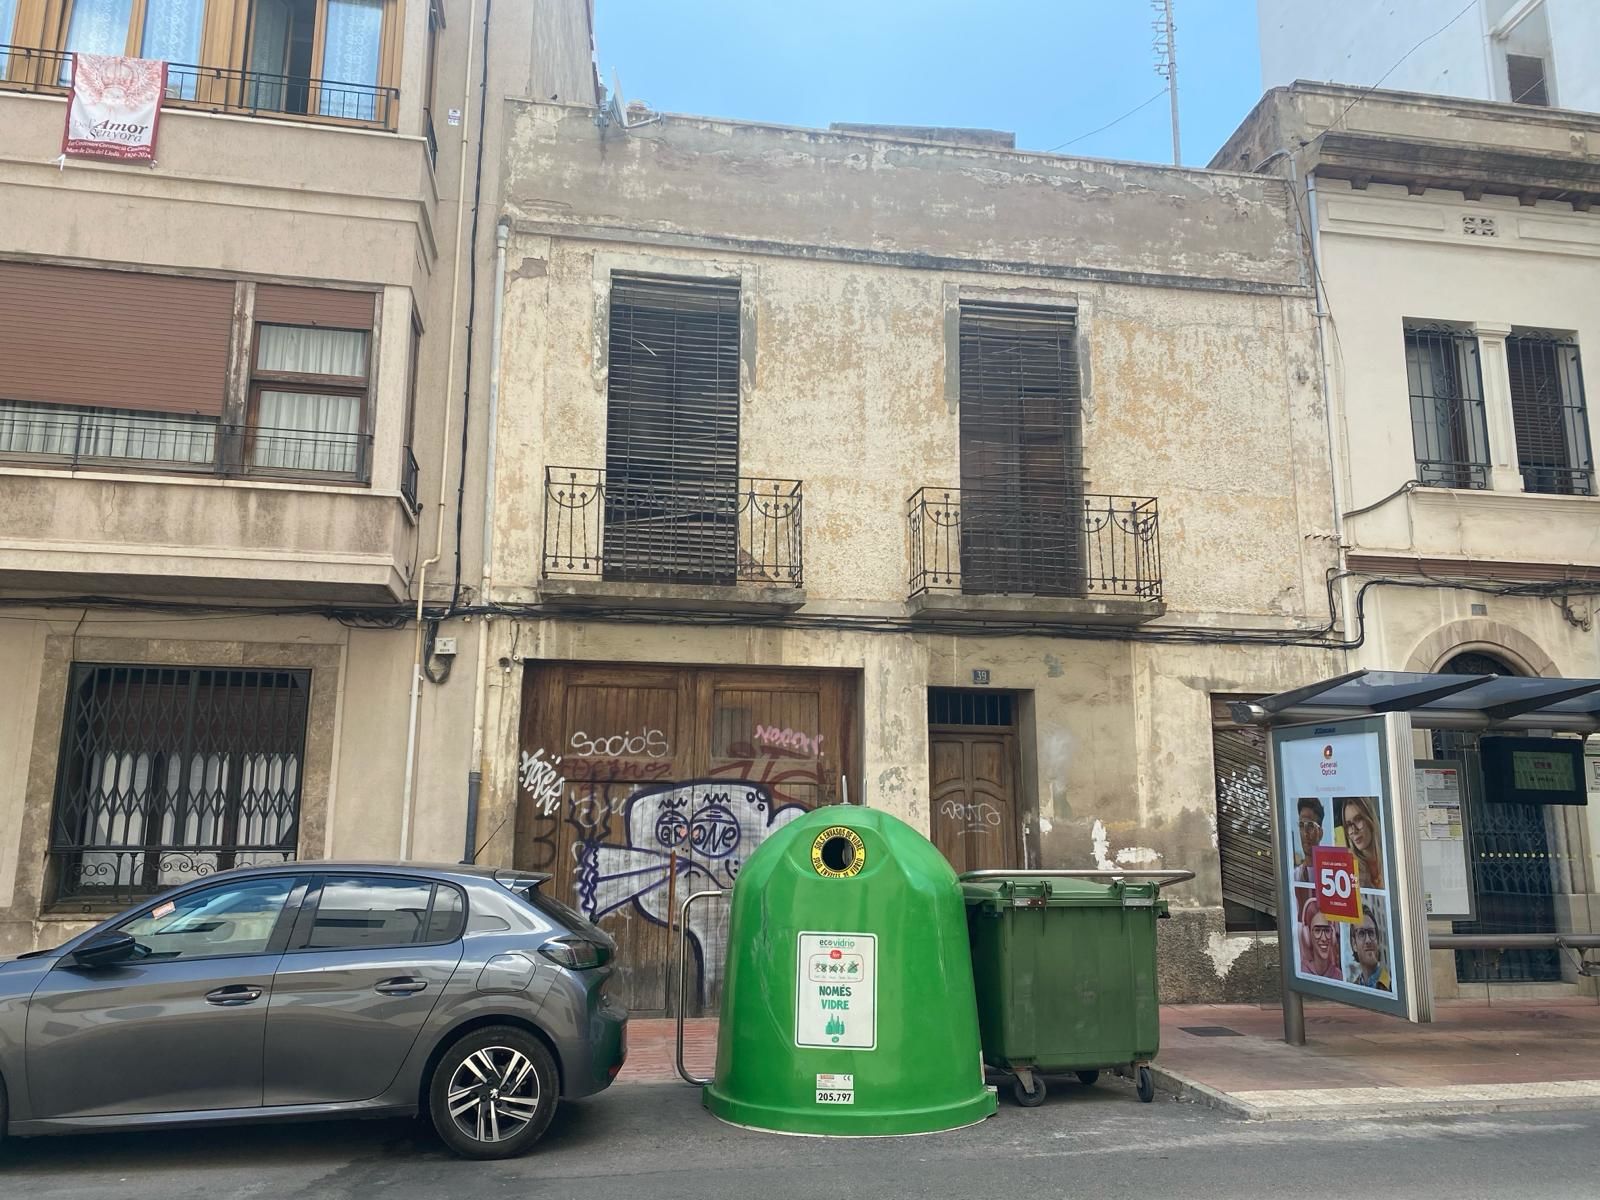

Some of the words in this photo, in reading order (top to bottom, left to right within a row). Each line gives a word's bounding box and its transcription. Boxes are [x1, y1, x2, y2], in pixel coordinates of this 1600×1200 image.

[93, 119, 149, 134] Amor
[976, 670, 988, 681] 39
[823, 828, 846, 840] ENVASOS
[819, 938, 855, 948] ecovidrio
[819, 983, 852, 997] NOMÉS
[821, 999, 850, 1010] VIDRE
[818, 1092, 852, 1102] 205.797
